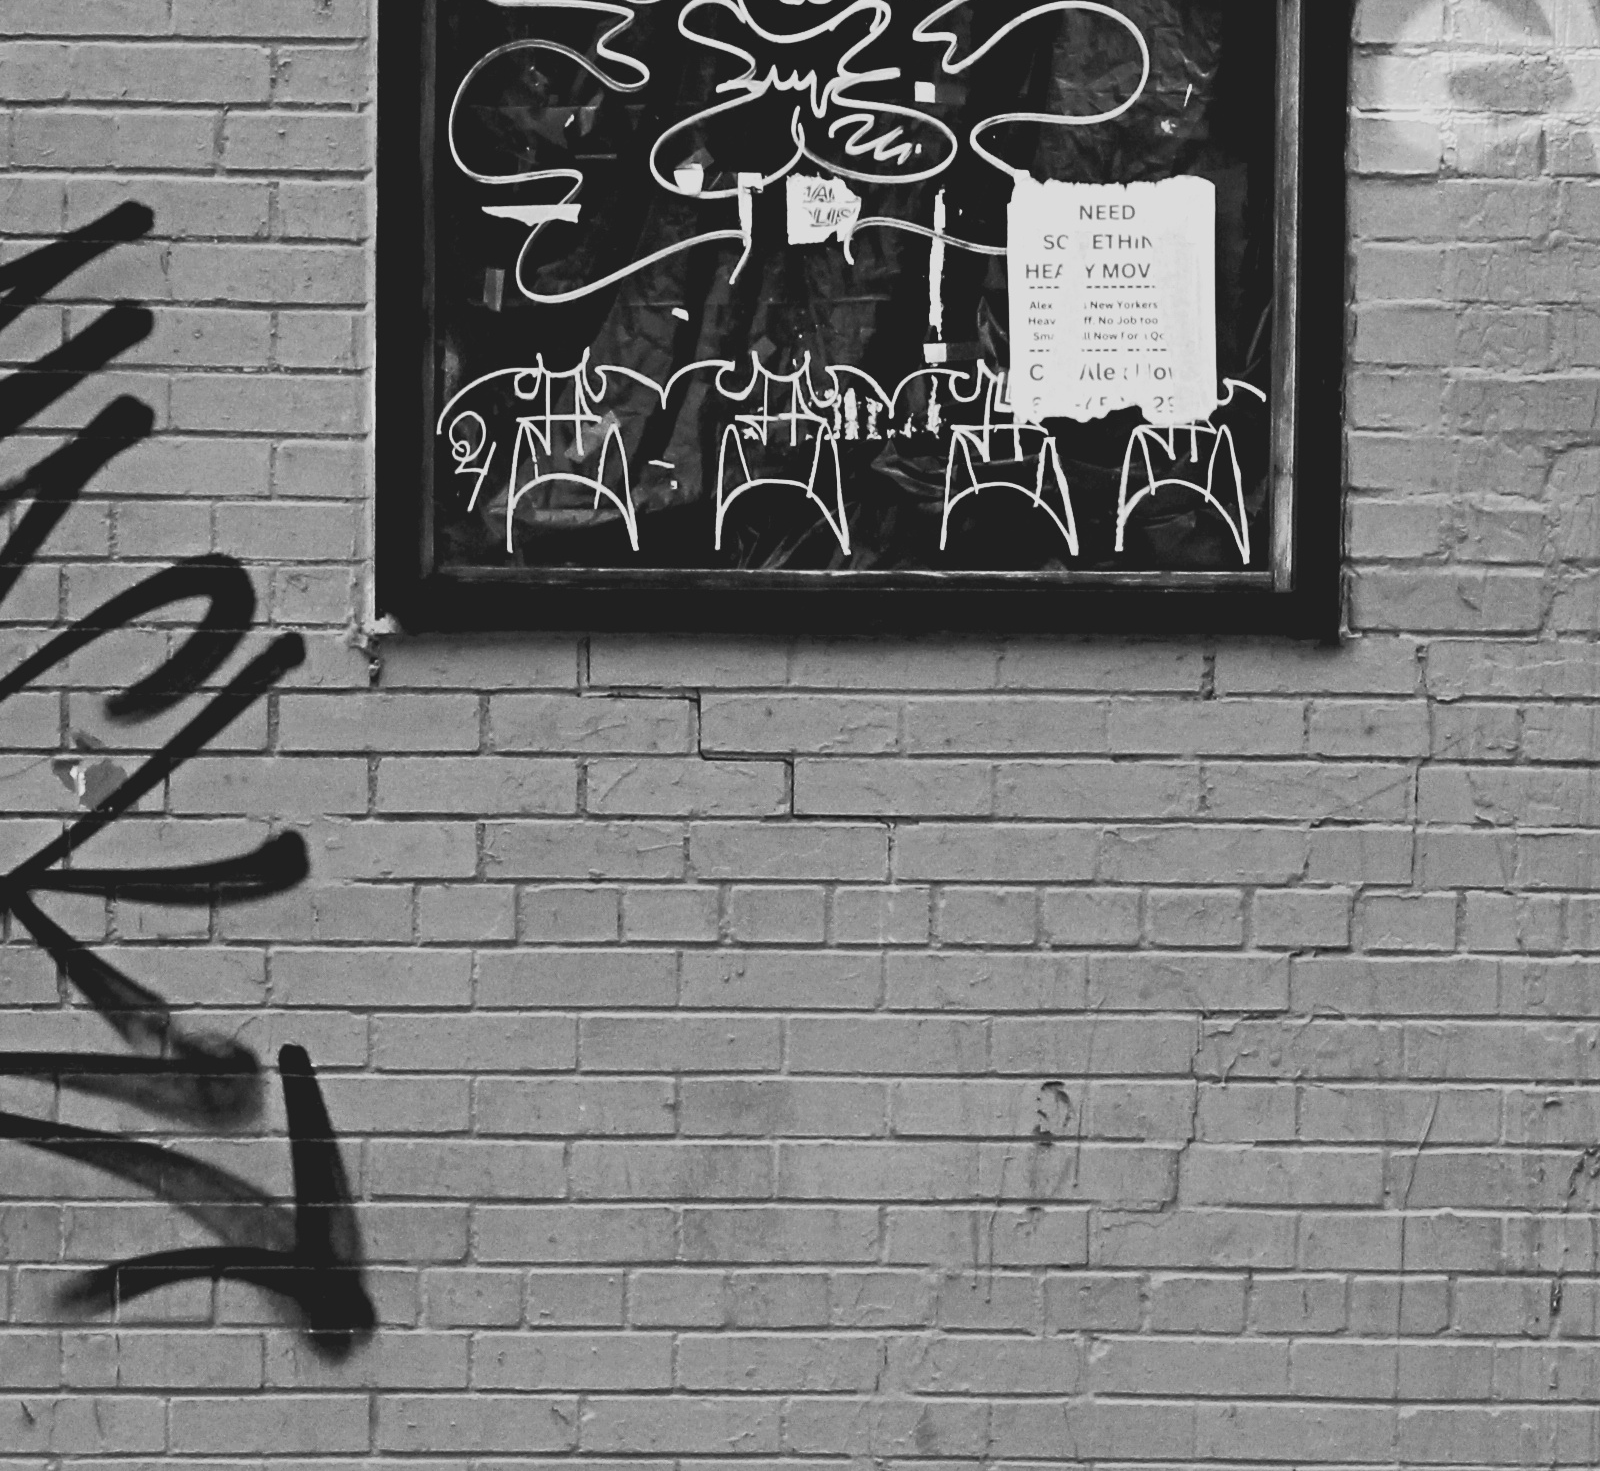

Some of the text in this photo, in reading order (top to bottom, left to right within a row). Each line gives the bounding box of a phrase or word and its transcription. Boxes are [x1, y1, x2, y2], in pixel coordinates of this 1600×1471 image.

[1079, 204, 1137, 221] NEED
[1090, 301, 1114, 309] New
[1116, 301, 1158, 309] Yorkers
[1098, 317, 1114, 325] No
[1117, 316, 1137, 325] Job
[1093, 332, 1118, 341] Now
